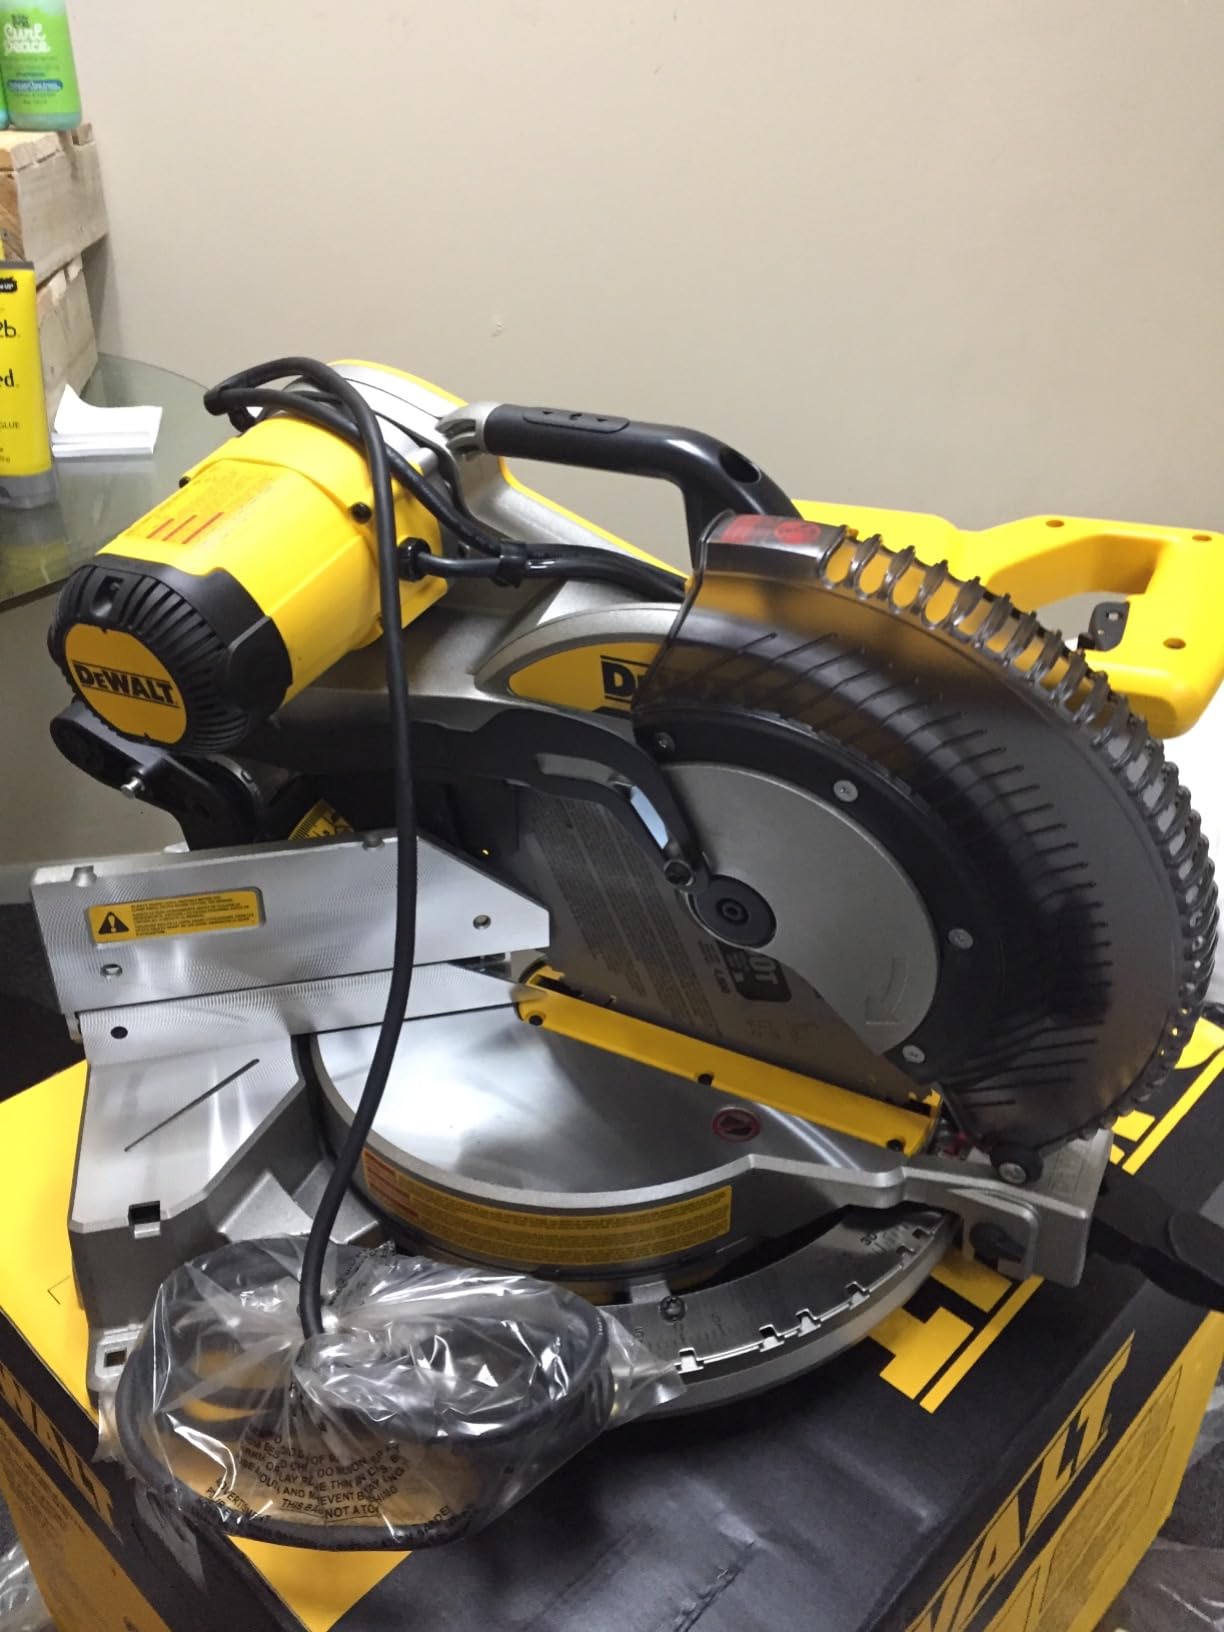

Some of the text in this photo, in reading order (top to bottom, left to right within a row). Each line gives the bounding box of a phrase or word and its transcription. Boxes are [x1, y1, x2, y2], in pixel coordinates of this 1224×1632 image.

[72, 660, 179, 707] DEWALT
[283, 1487, 305, 1499] AND
[325, 1505, 350, 1518] NOT
[352, 1505, 361, 1514] A
